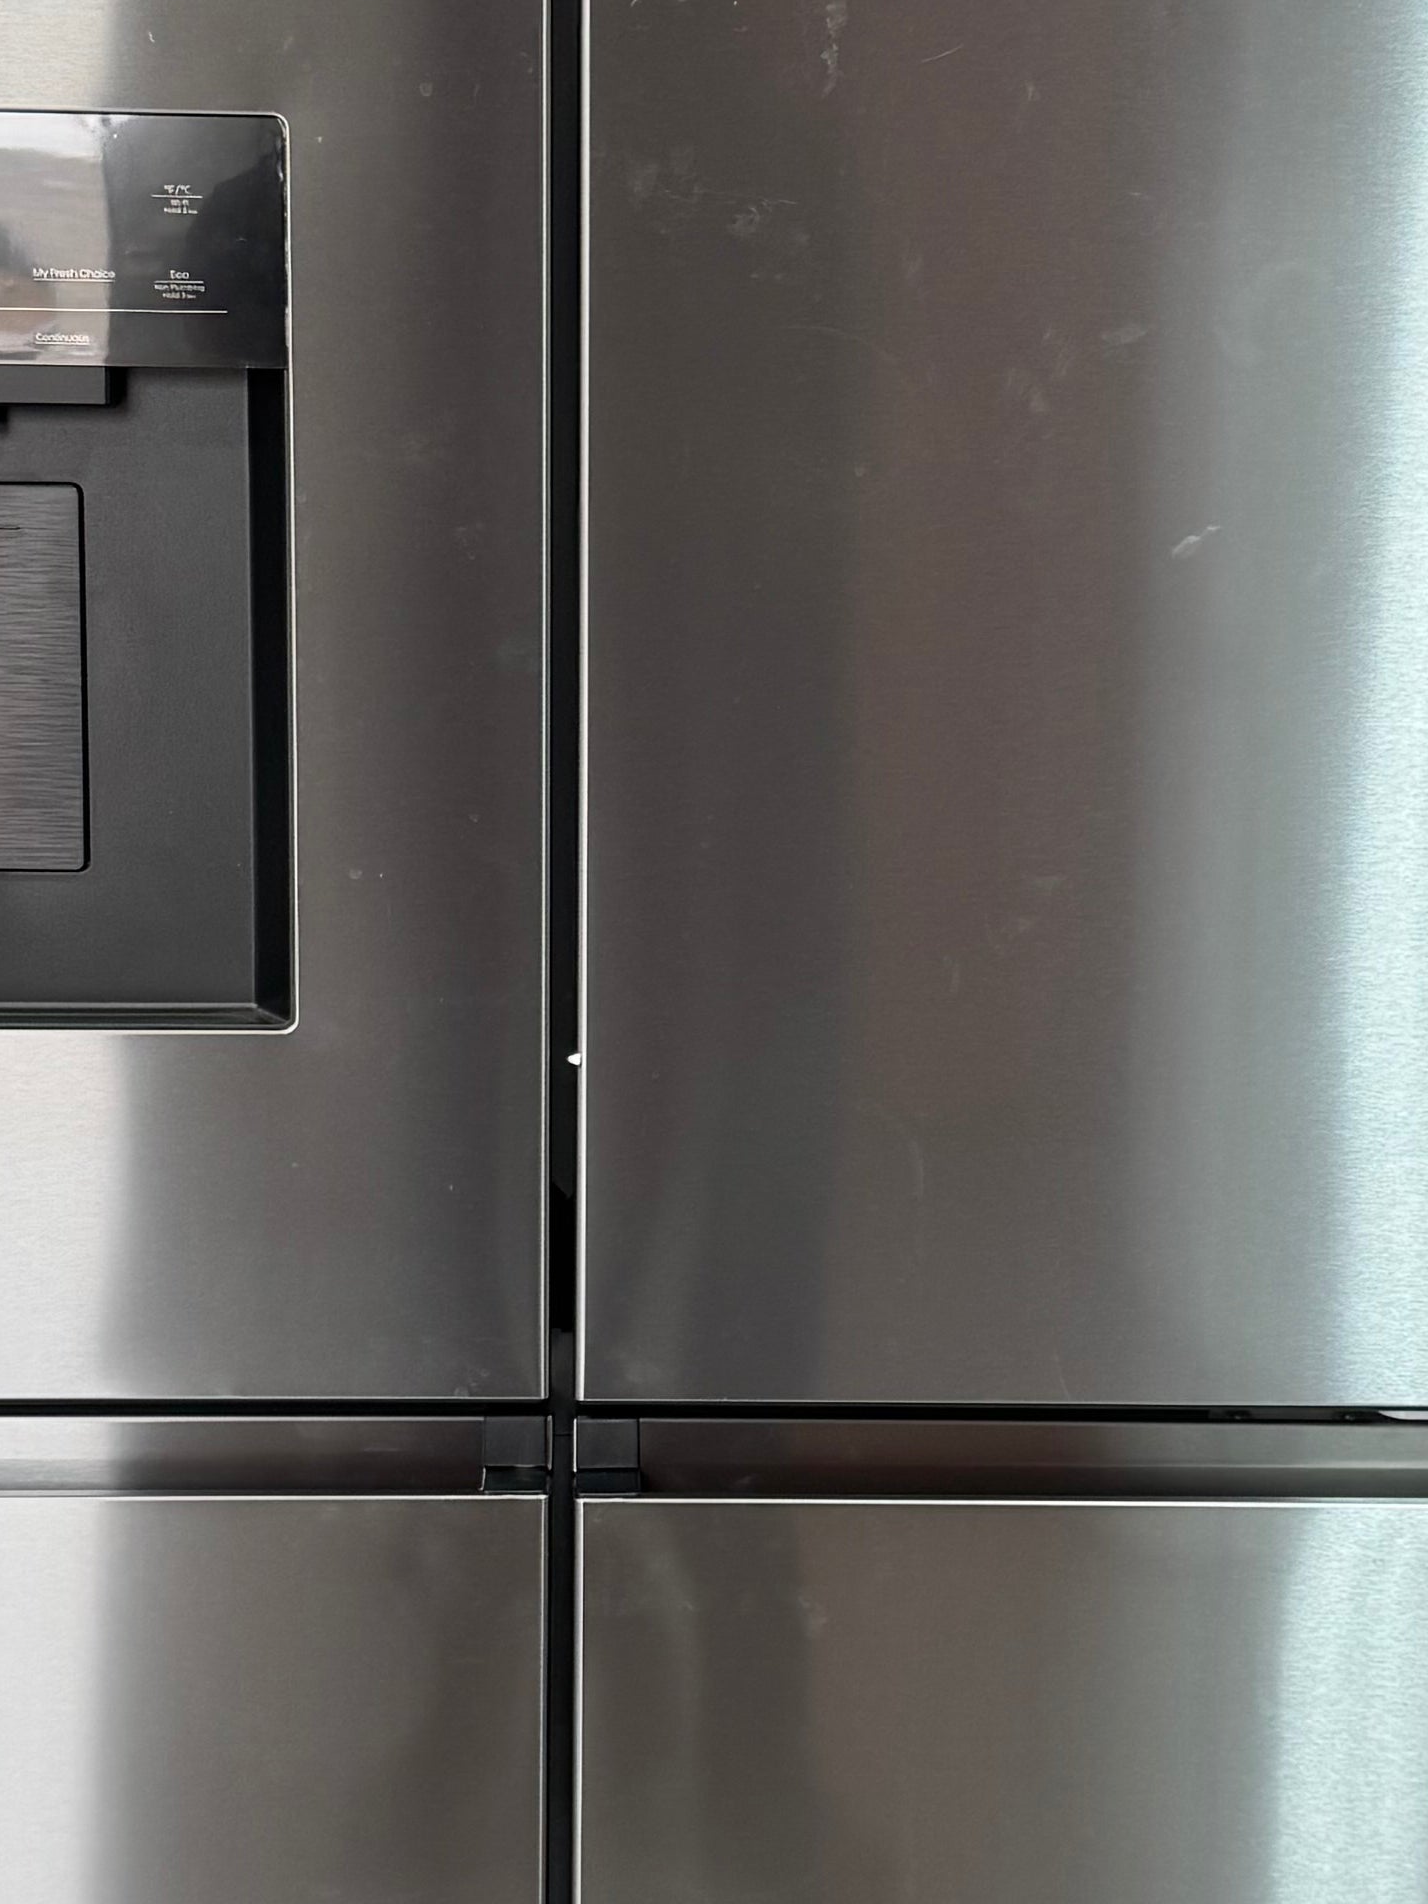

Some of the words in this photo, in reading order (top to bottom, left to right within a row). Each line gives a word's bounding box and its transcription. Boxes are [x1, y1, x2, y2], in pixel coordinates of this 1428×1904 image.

[33, 267, 49, 279] My
[50, 267, 76, 279] Fresh
[79, 268, 116, 279] Choice
[169, 269, 190, 279] Eco
[35, 332, 90, 343] Continuous
